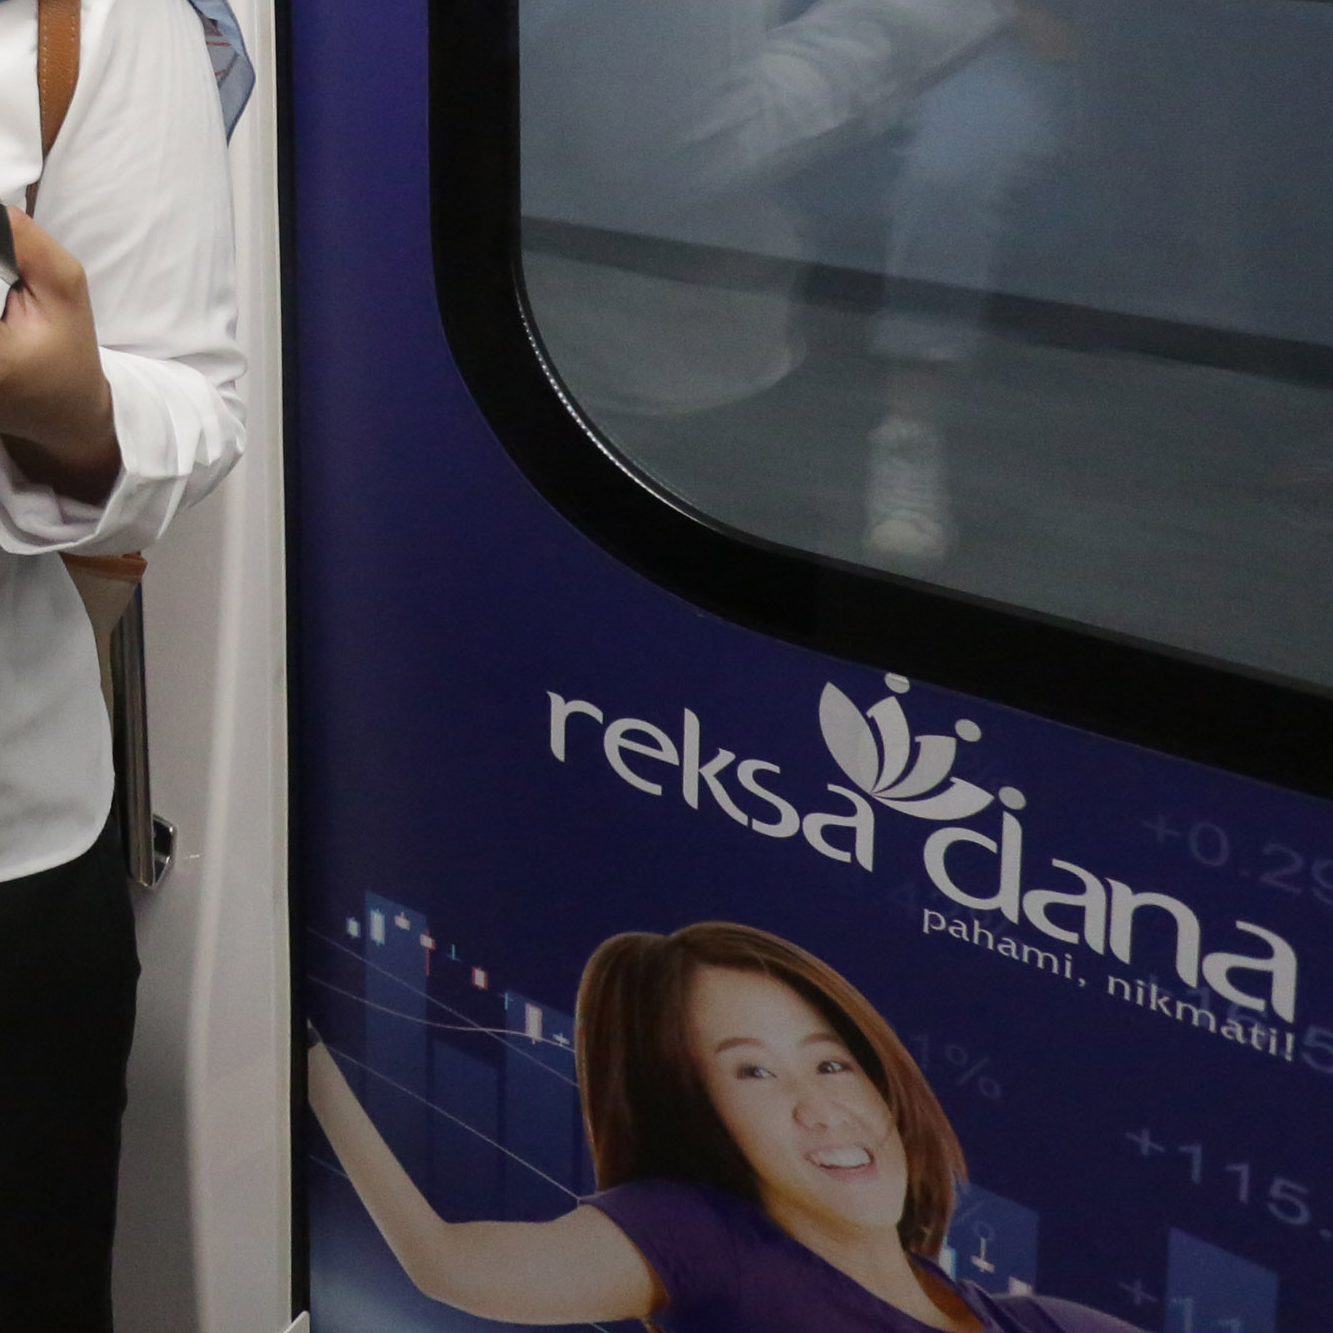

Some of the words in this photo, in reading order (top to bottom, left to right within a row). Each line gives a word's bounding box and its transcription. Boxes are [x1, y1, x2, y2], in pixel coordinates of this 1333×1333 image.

[545, 689, 876, 873] reksa
[922, 807, 1298, 1024] dana
[921, 906, 1088, 989] pahami,
[1106, 973, 1296, 1063] nikmati!
